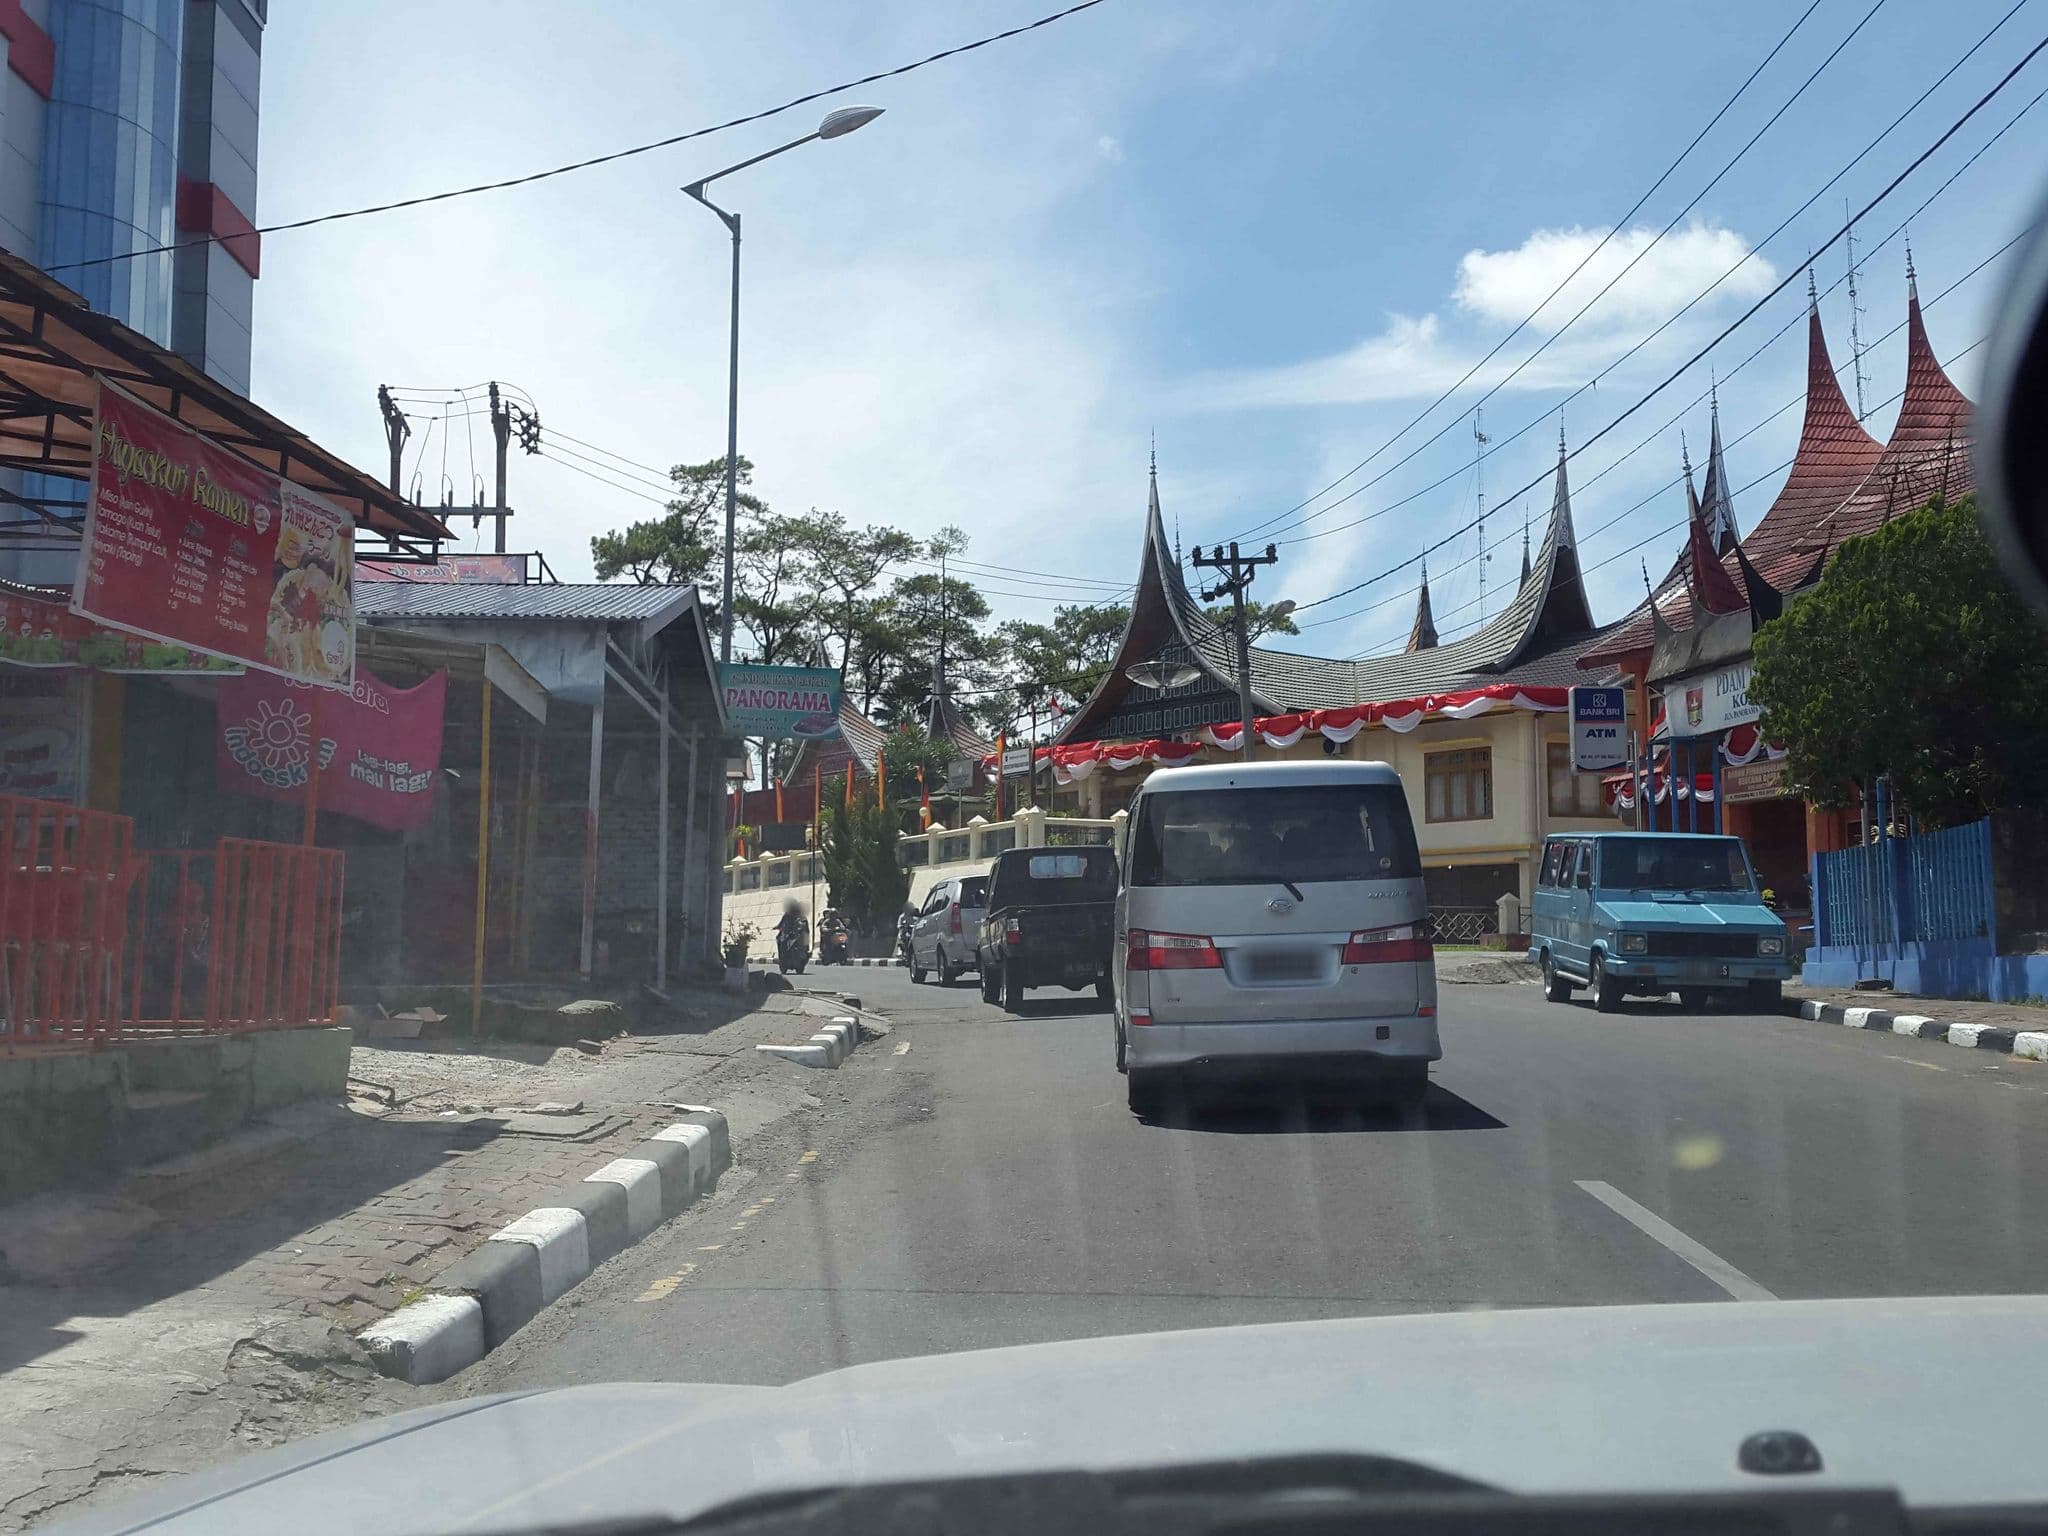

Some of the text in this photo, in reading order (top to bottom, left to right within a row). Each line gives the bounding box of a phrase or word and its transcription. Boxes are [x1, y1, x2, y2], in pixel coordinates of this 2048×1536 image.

[193, 466, 249, 528] Ramen
[1717, 667, 1746, 696] PDAM
[725, 687, 832, 713] PANORAMA
[1580, 708, 1620, 716] BANK BRI
[1732, 693, 1748, 708] KO
[1585, 729, 1616, 738] ATM
[350, 763, 383, 788] mau
